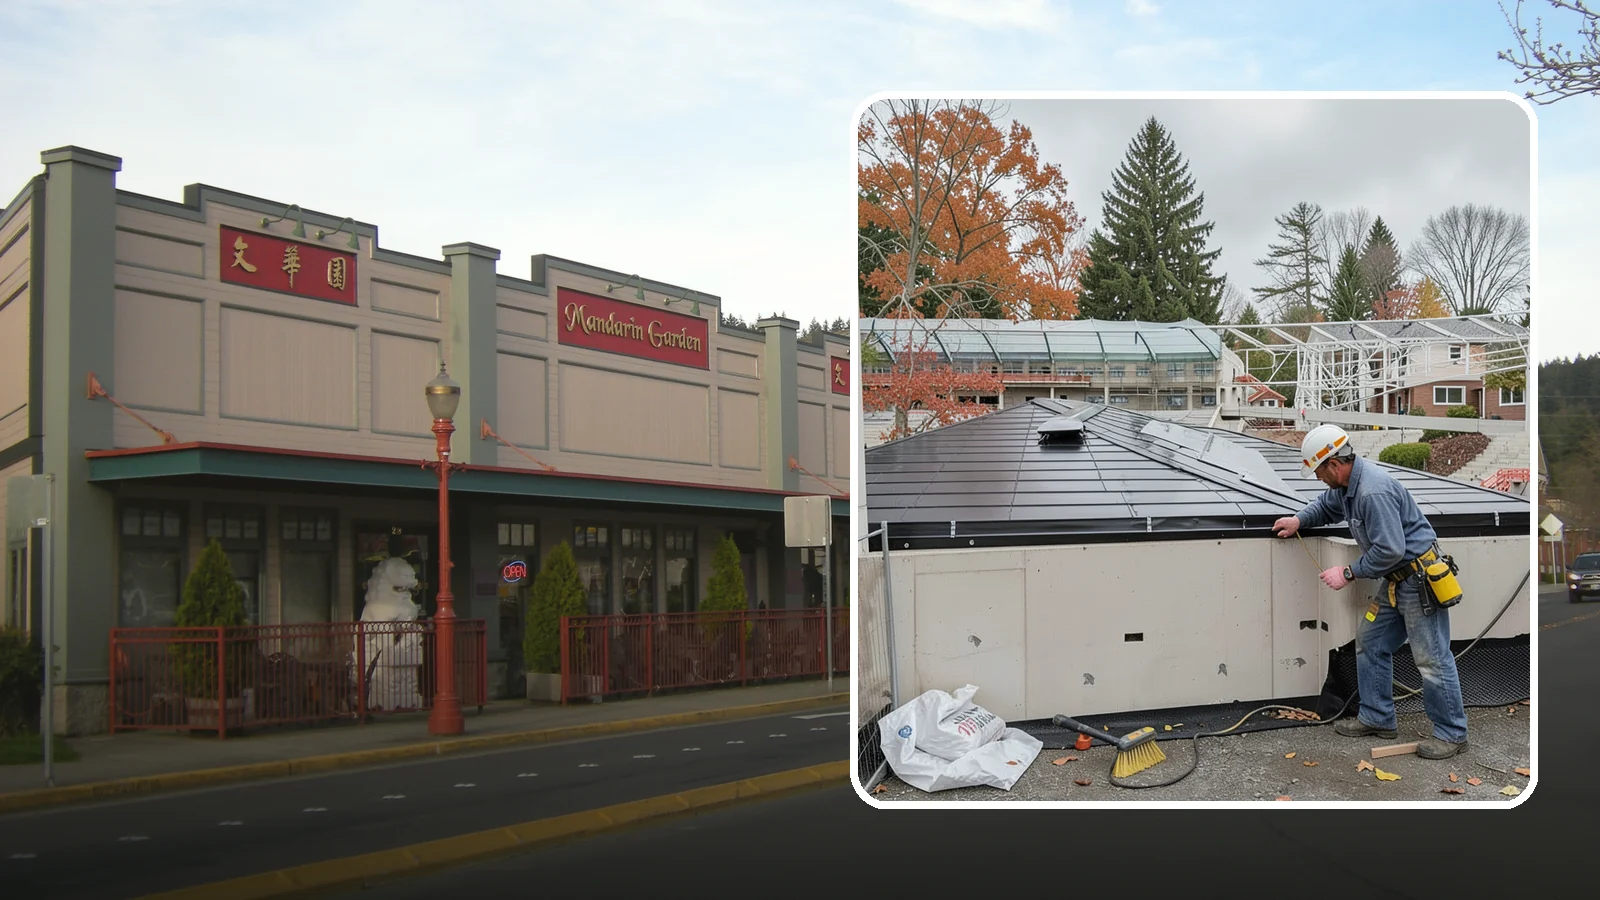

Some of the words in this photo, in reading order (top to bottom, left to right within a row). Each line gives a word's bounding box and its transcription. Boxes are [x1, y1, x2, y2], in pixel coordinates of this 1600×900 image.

[230, 235, 346, 291] 文華園
[564, 302, 644, 341] Mandarin
[648, 320, 702, 352] Garden
[503, 565, 527, 578] OPEN
